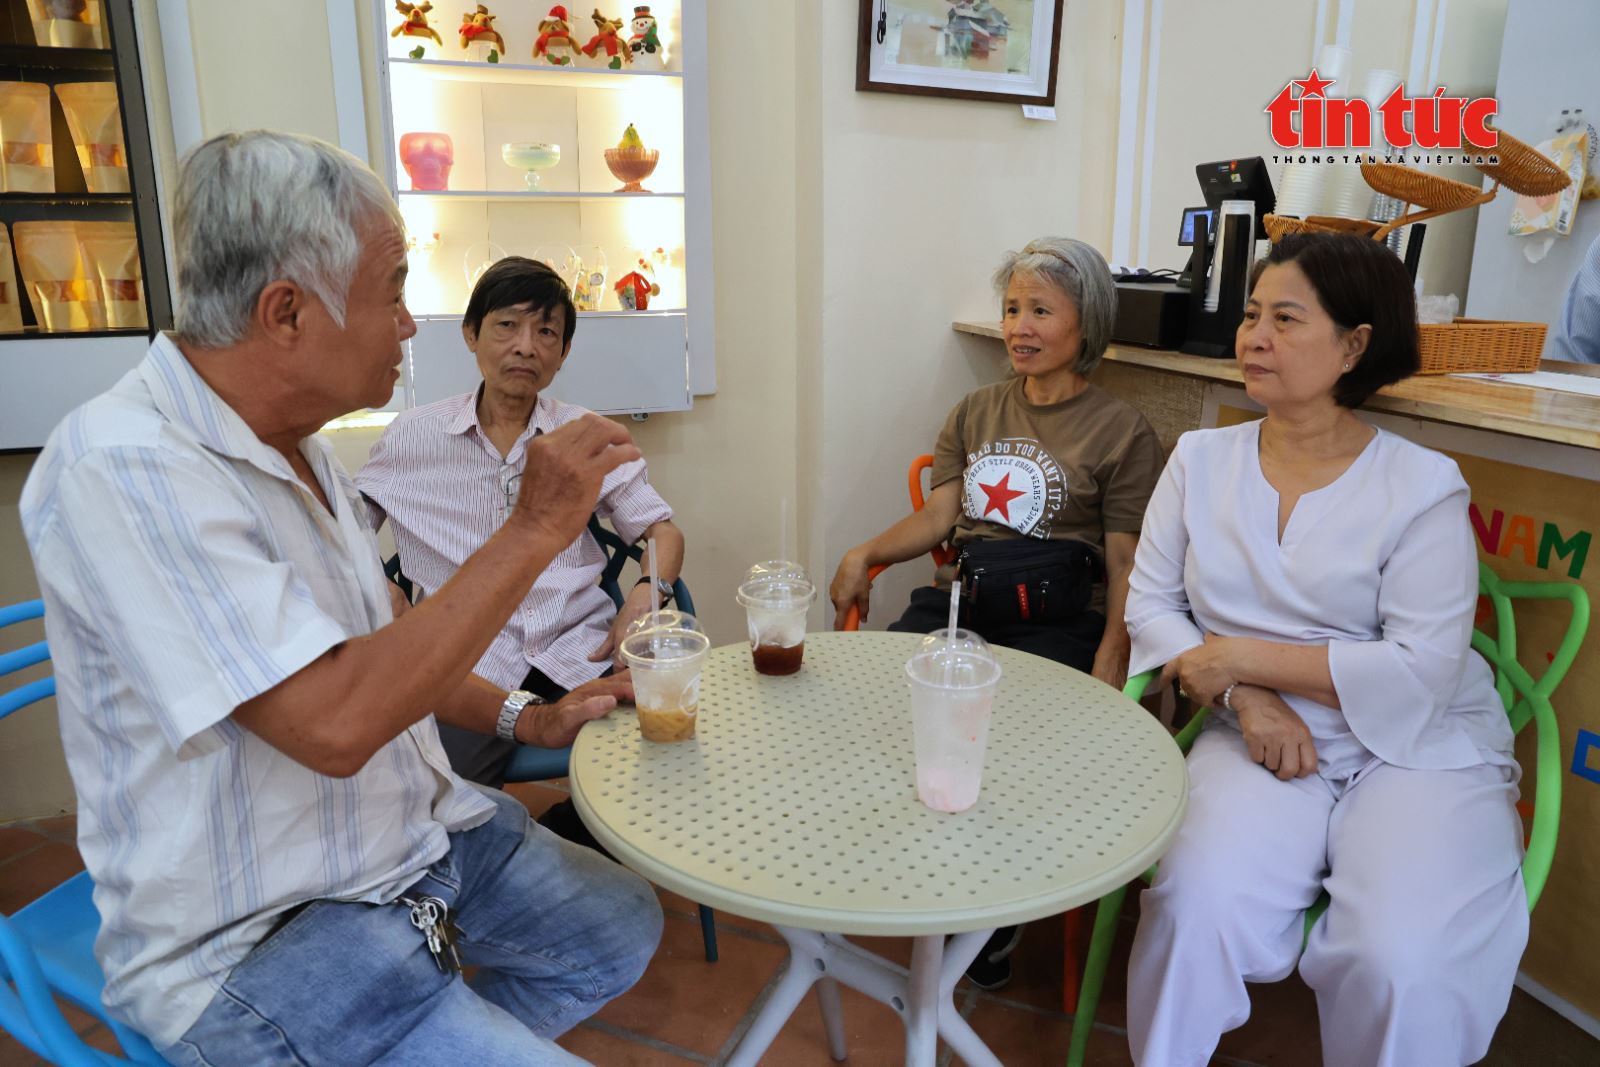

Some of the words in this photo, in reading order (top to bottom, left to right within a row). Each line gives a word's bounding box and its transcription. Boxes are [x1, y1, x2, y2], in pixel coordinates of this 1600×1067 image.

[969, 443, 991, 462] BAD
[995, 442, 1010, 453] DO
[1015, 443, 1036, 457] YOU
[1036, 450, 1061, 483] WANT
[1048, 488, 1062, 511] IT?
